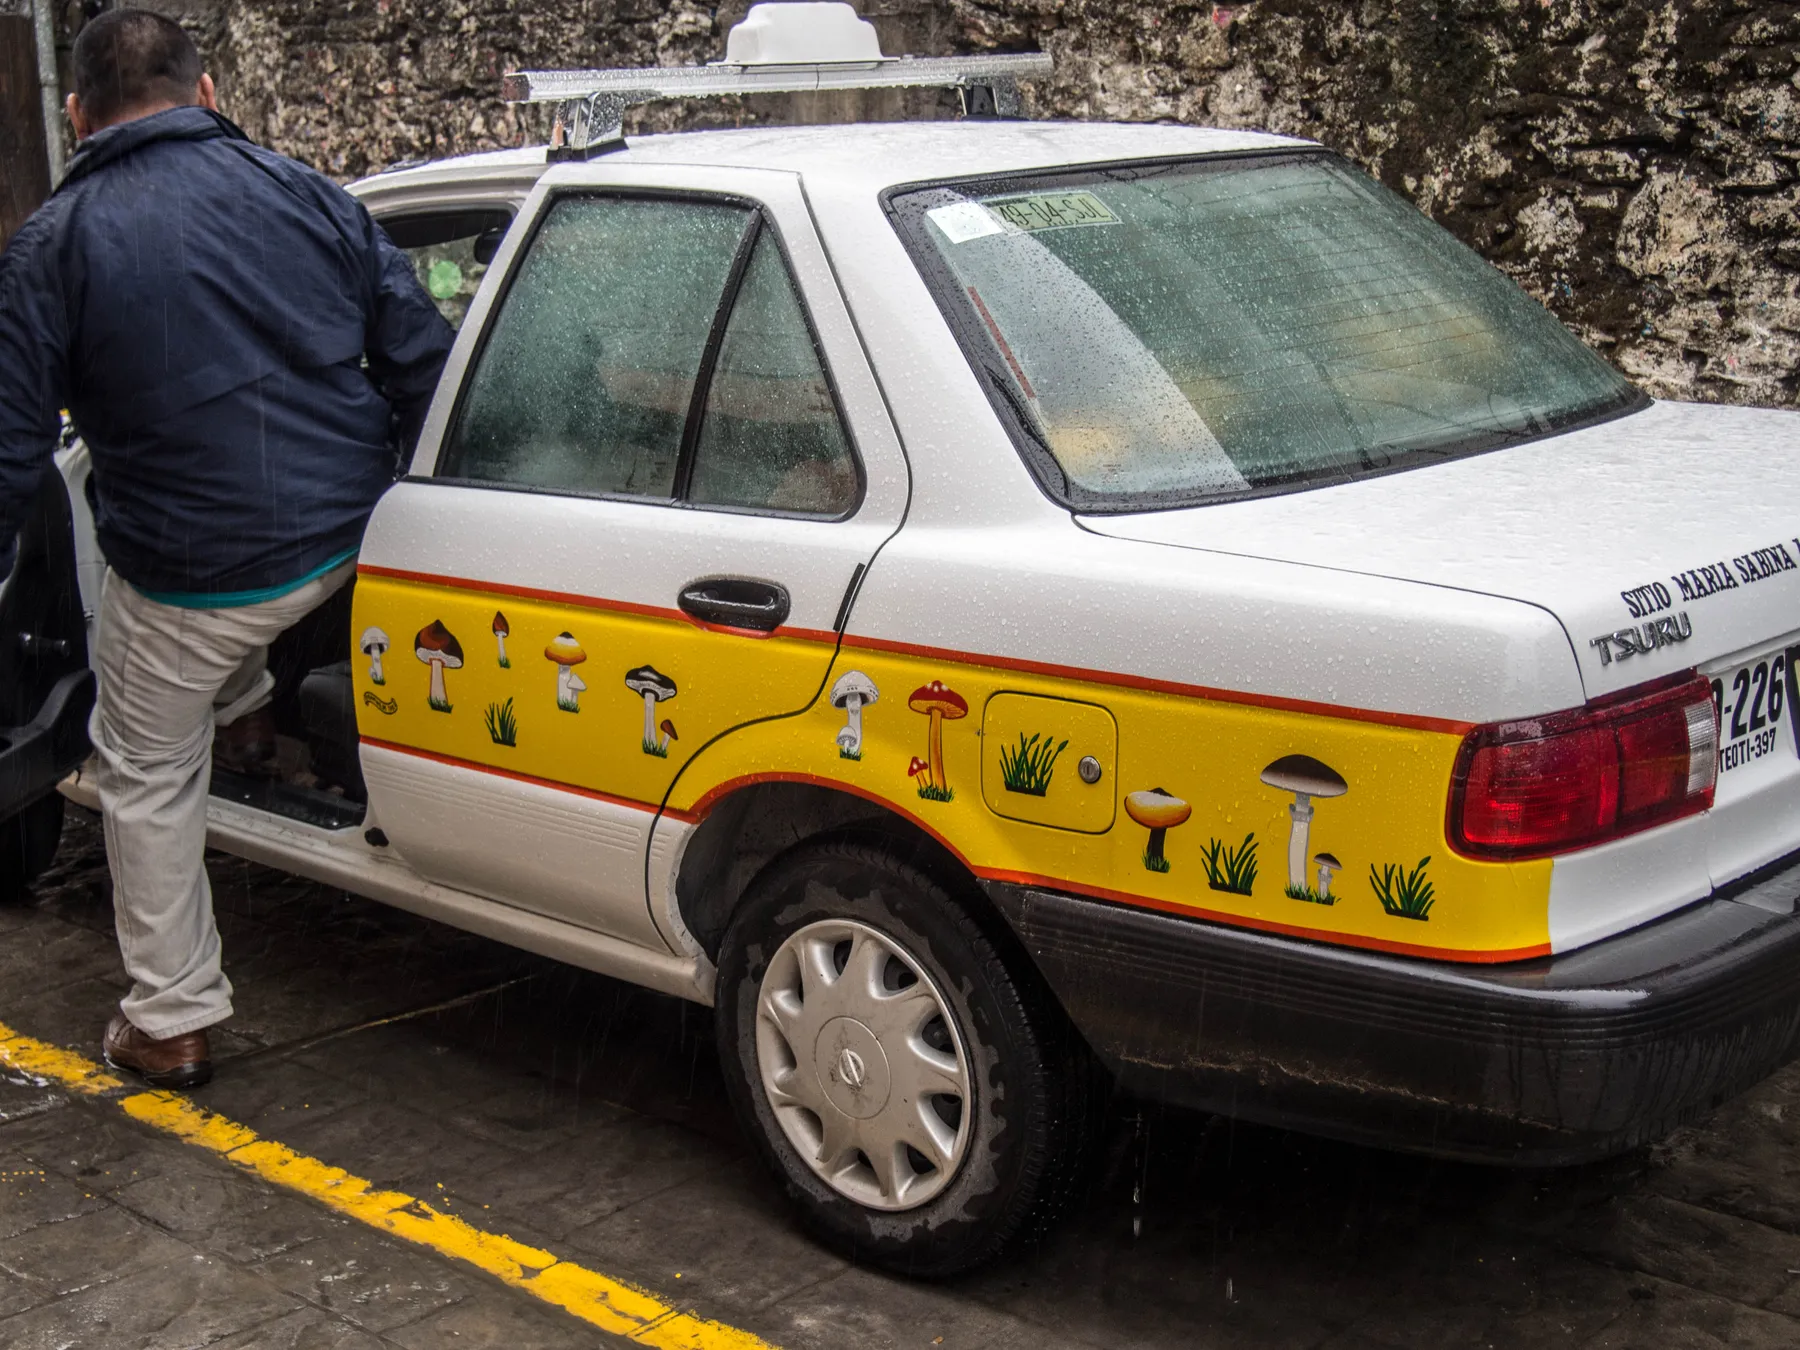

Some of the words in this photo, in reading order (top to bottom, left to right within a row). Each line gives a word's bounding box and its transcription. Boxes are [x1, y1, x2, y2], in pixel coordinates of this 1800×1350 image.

[1621, 582, 1672, 619] SITIO
[1671, 562, 1739, 602] MARIA
[1733, 543, 1797, 583] SABINA
[1589, 611, 1692, 665] TSURU
